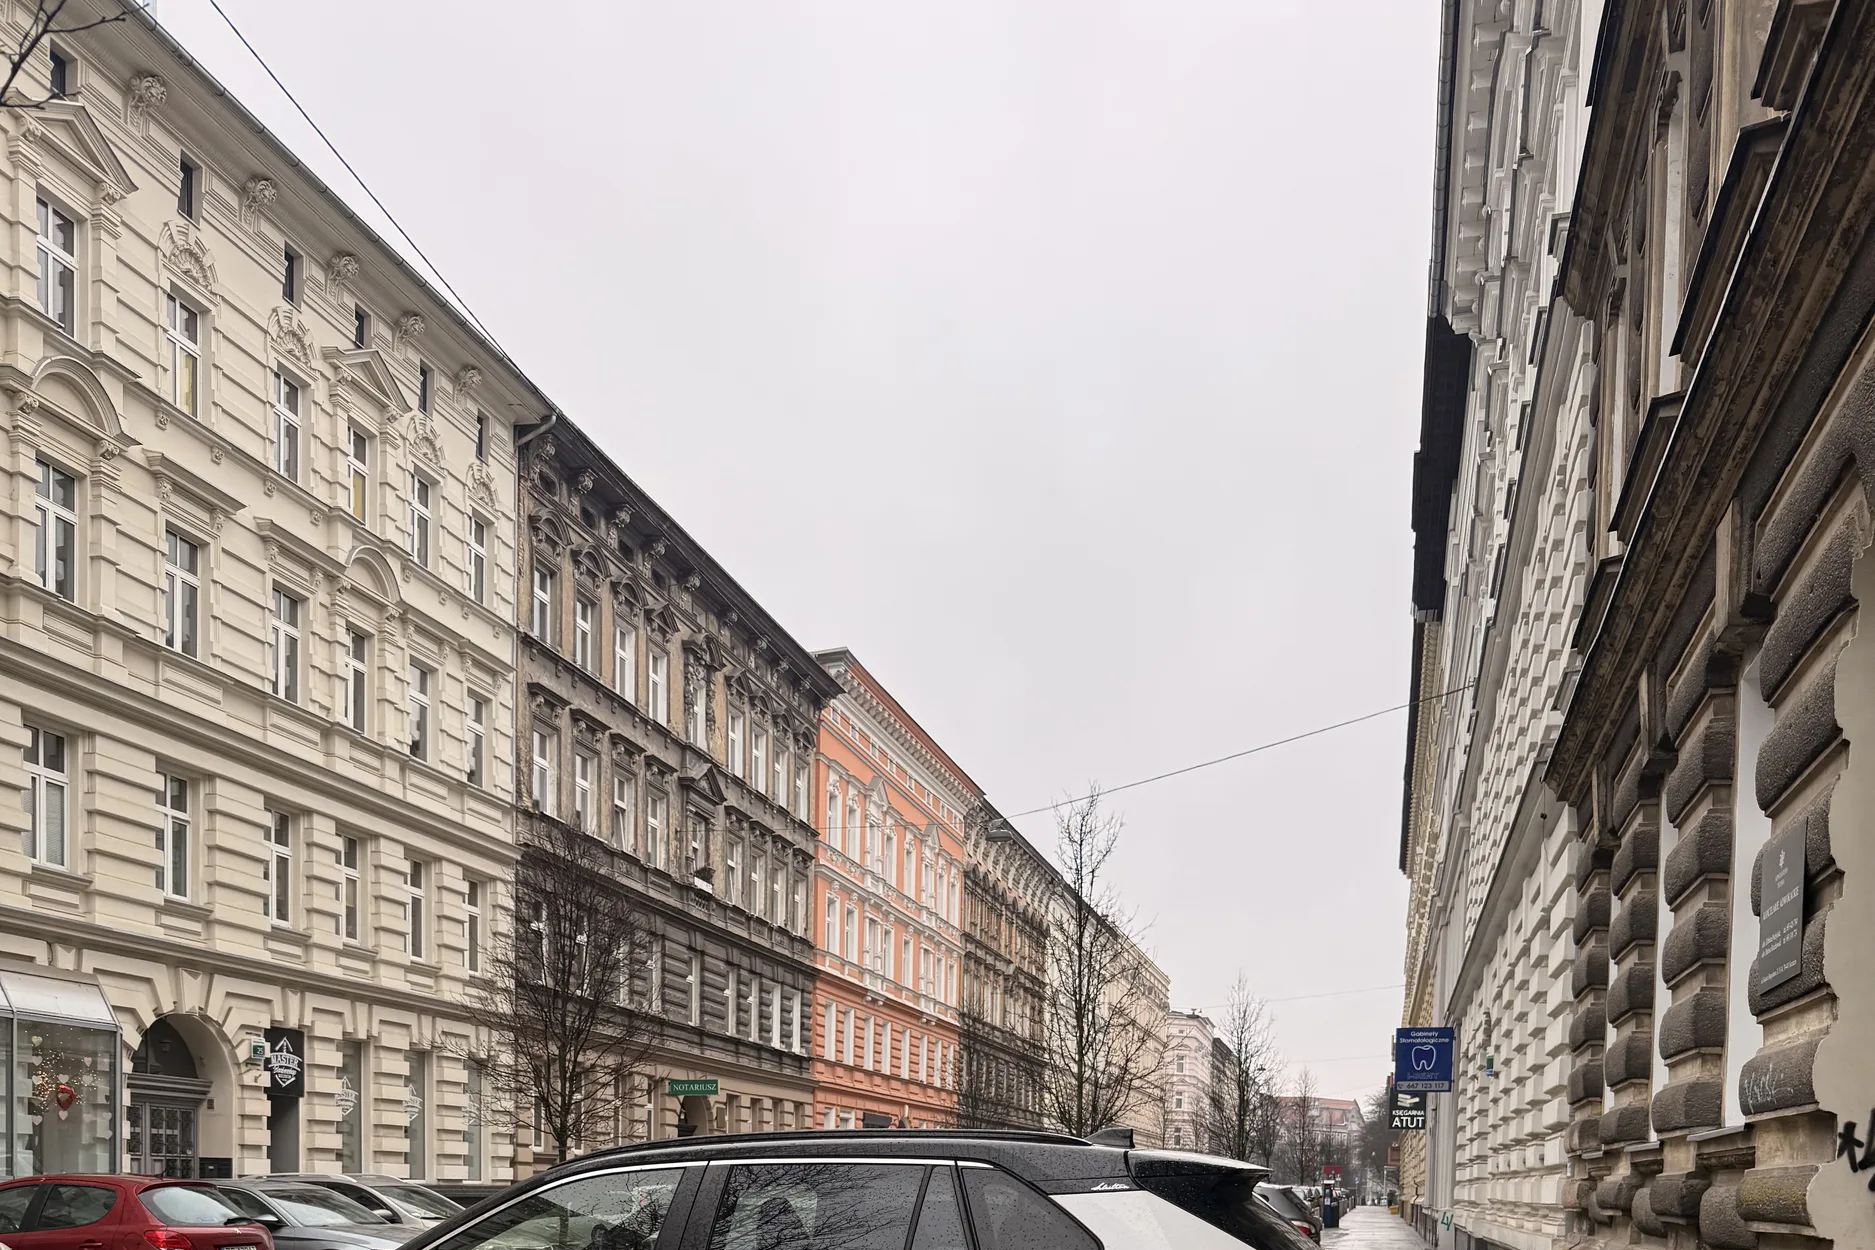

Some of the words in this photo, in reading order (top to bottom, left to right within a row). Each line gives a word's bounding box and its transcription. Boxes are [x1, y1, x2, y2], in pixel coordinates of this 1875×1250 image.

[271, 1054, 298, 1068] MASTER
[672, 1083, 717, 1091] NOTARIUSZ
[1392, 1117, 1425, 1128] ATUT
